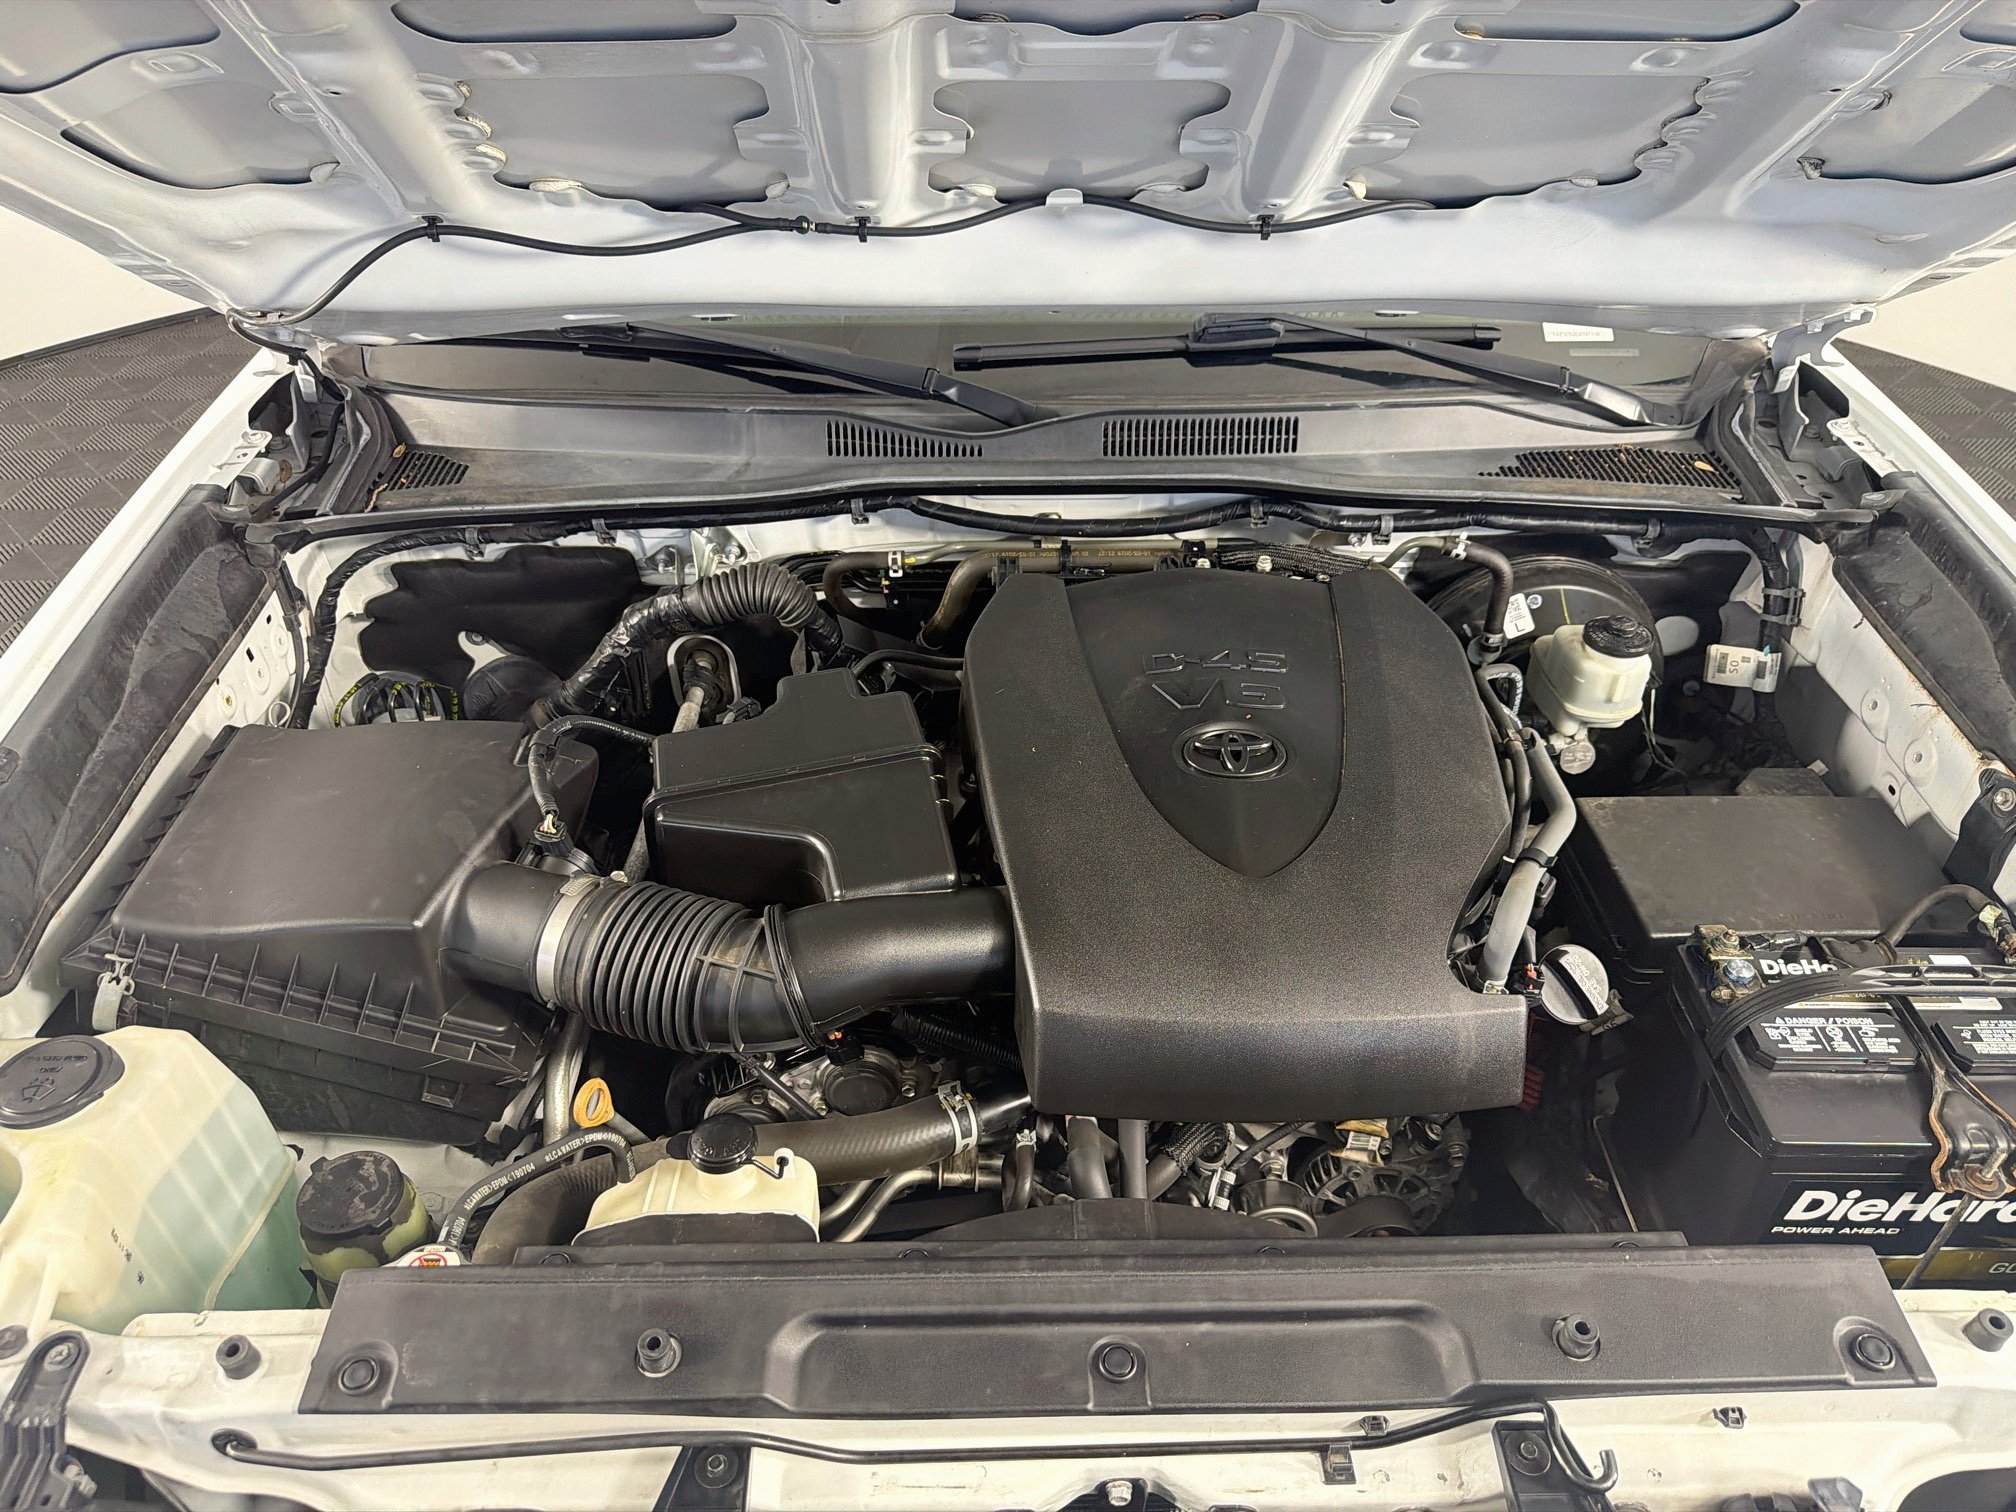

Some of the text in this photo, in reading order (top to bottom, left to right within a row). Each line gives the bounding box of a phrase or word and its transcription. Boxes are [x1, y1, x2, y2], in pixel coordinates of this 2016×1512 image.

[1758, 958, 1838, 975] DieHa
[1577, 974, 1588, 986] OIL
[1589, 978, 1602, 992] SAE
[1784, 1017, 1827, 1025] DANGER
[1834, 1017, 1874, 1025] POISON
[1771, 1226, 1901, 1235] POWER AHEAD
